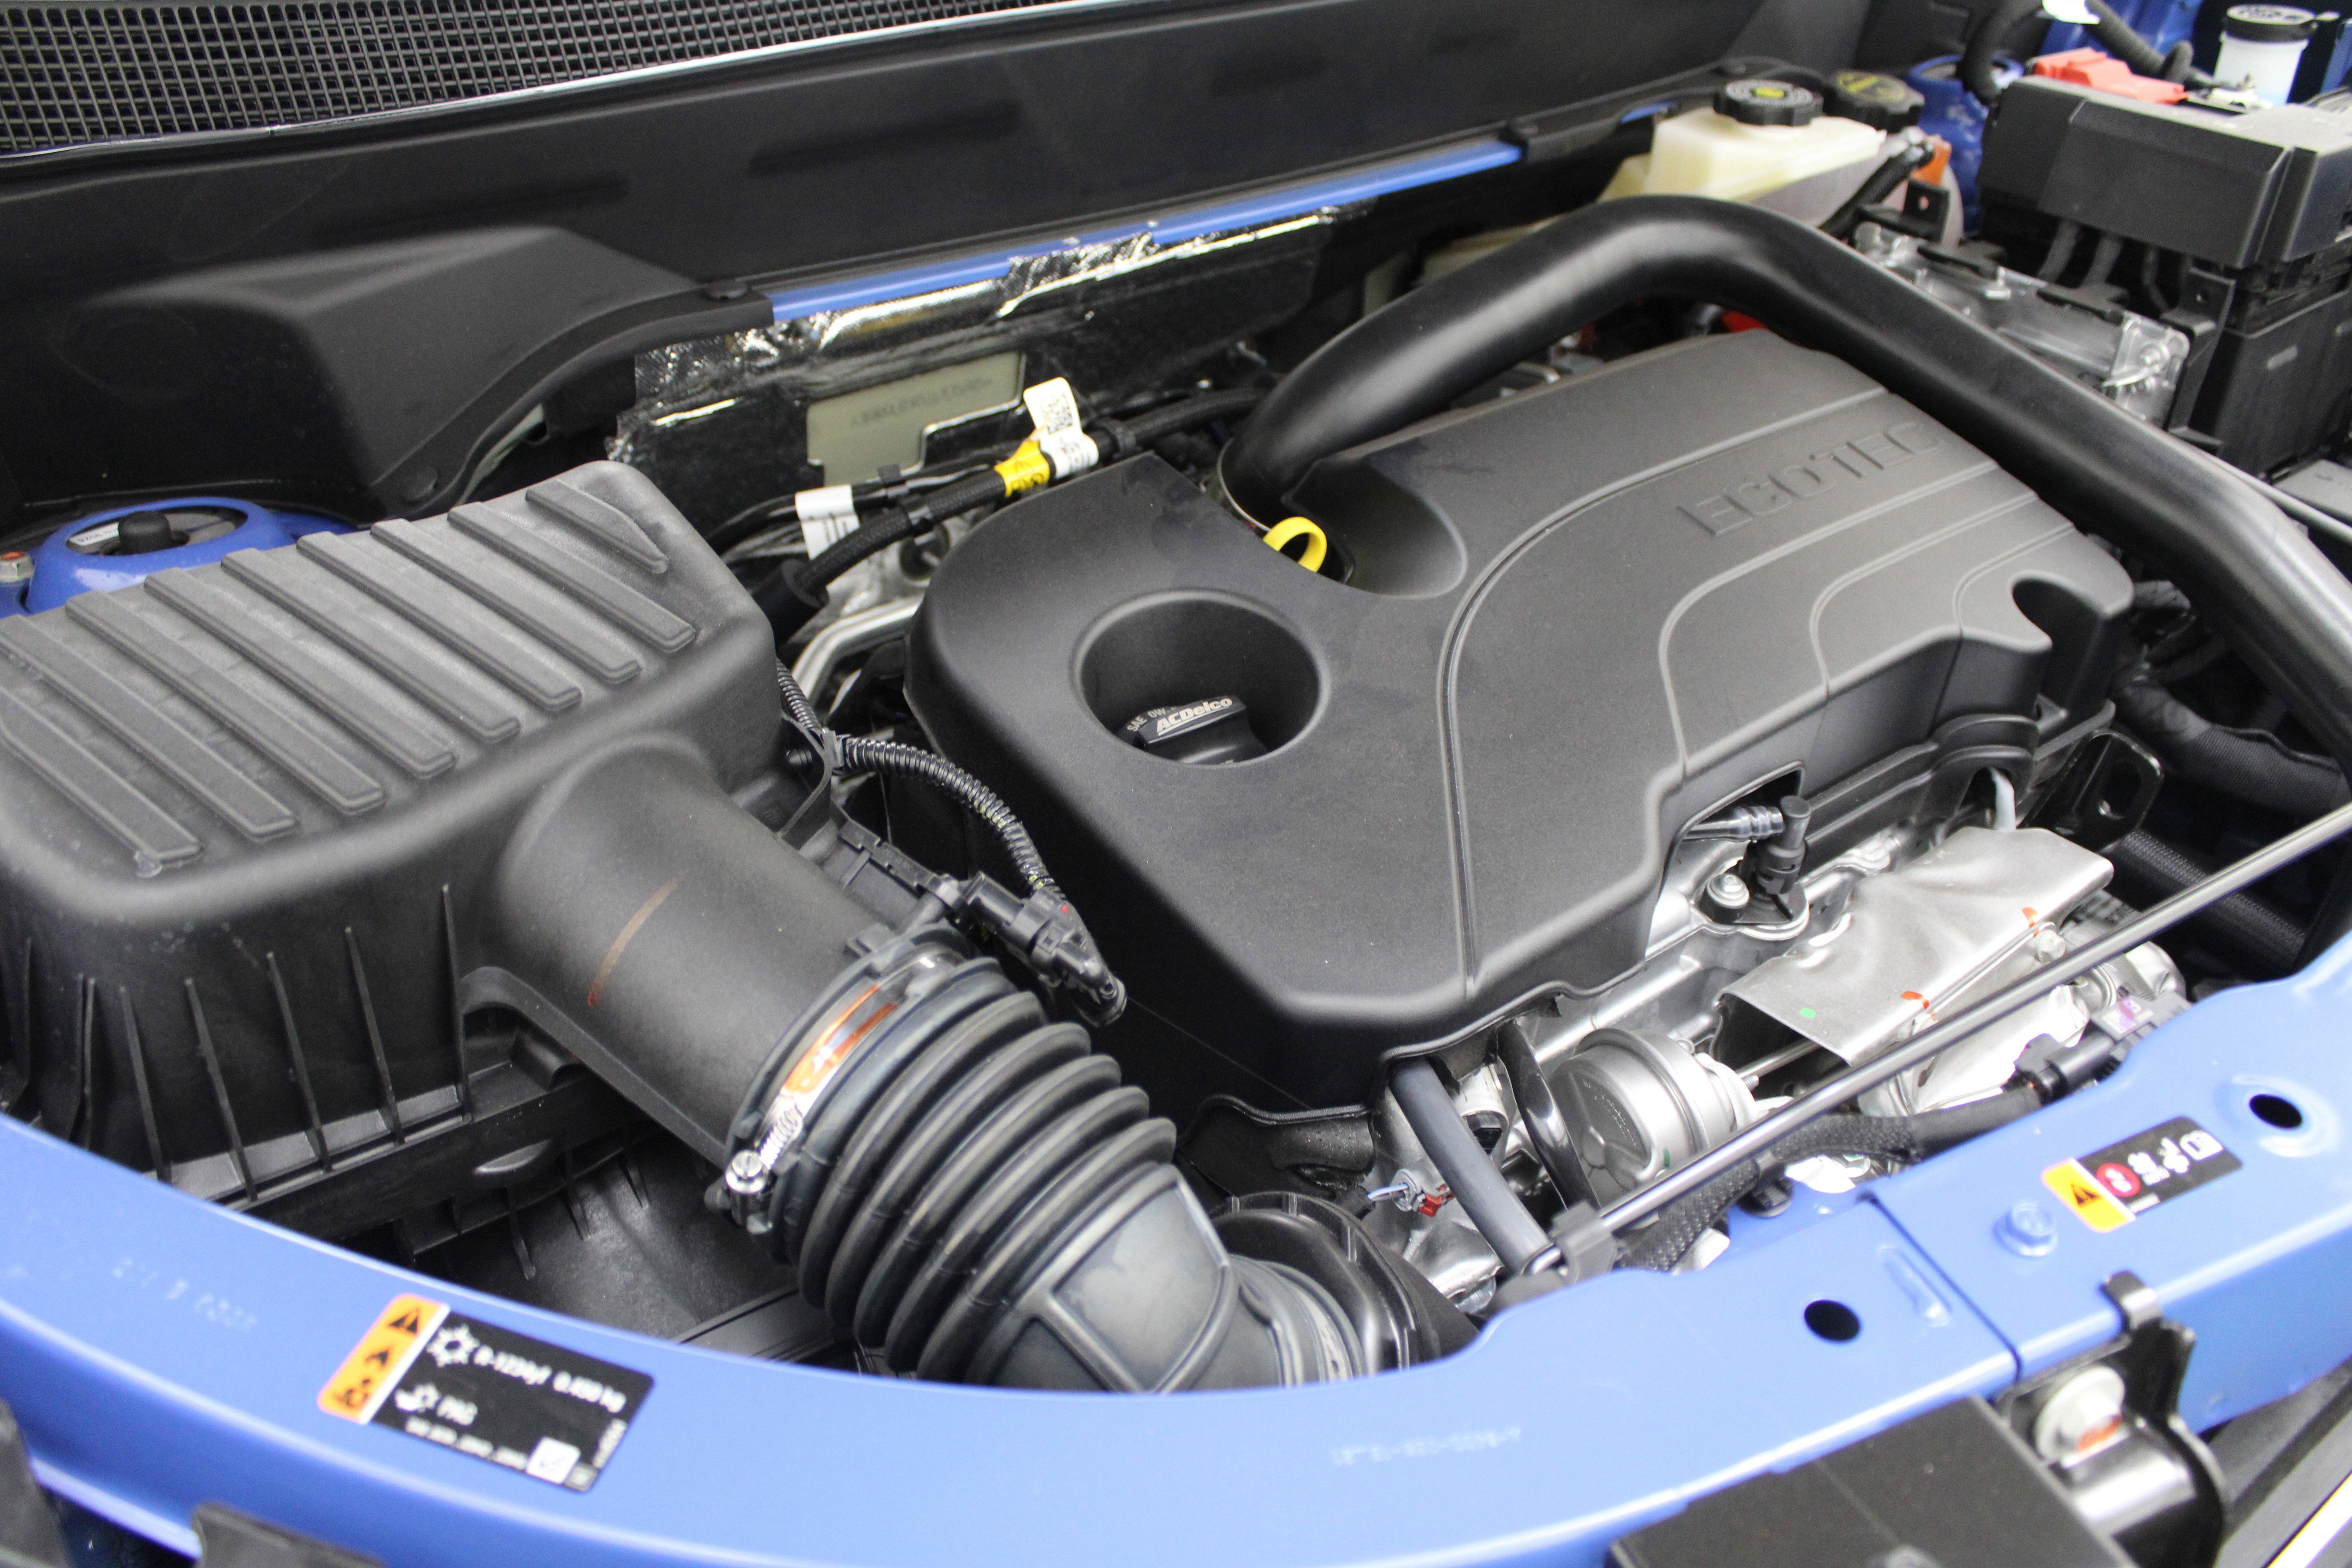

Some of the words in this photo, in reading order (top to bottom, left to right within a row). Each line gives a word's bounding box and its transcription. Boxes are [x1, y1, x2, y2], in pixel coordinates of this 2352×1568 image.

[1676, 421, 1945, 537] ECOTEC
[1127, 716, 1148, 732] SAE
[1156, 697, 1233, 733] ACDelco
